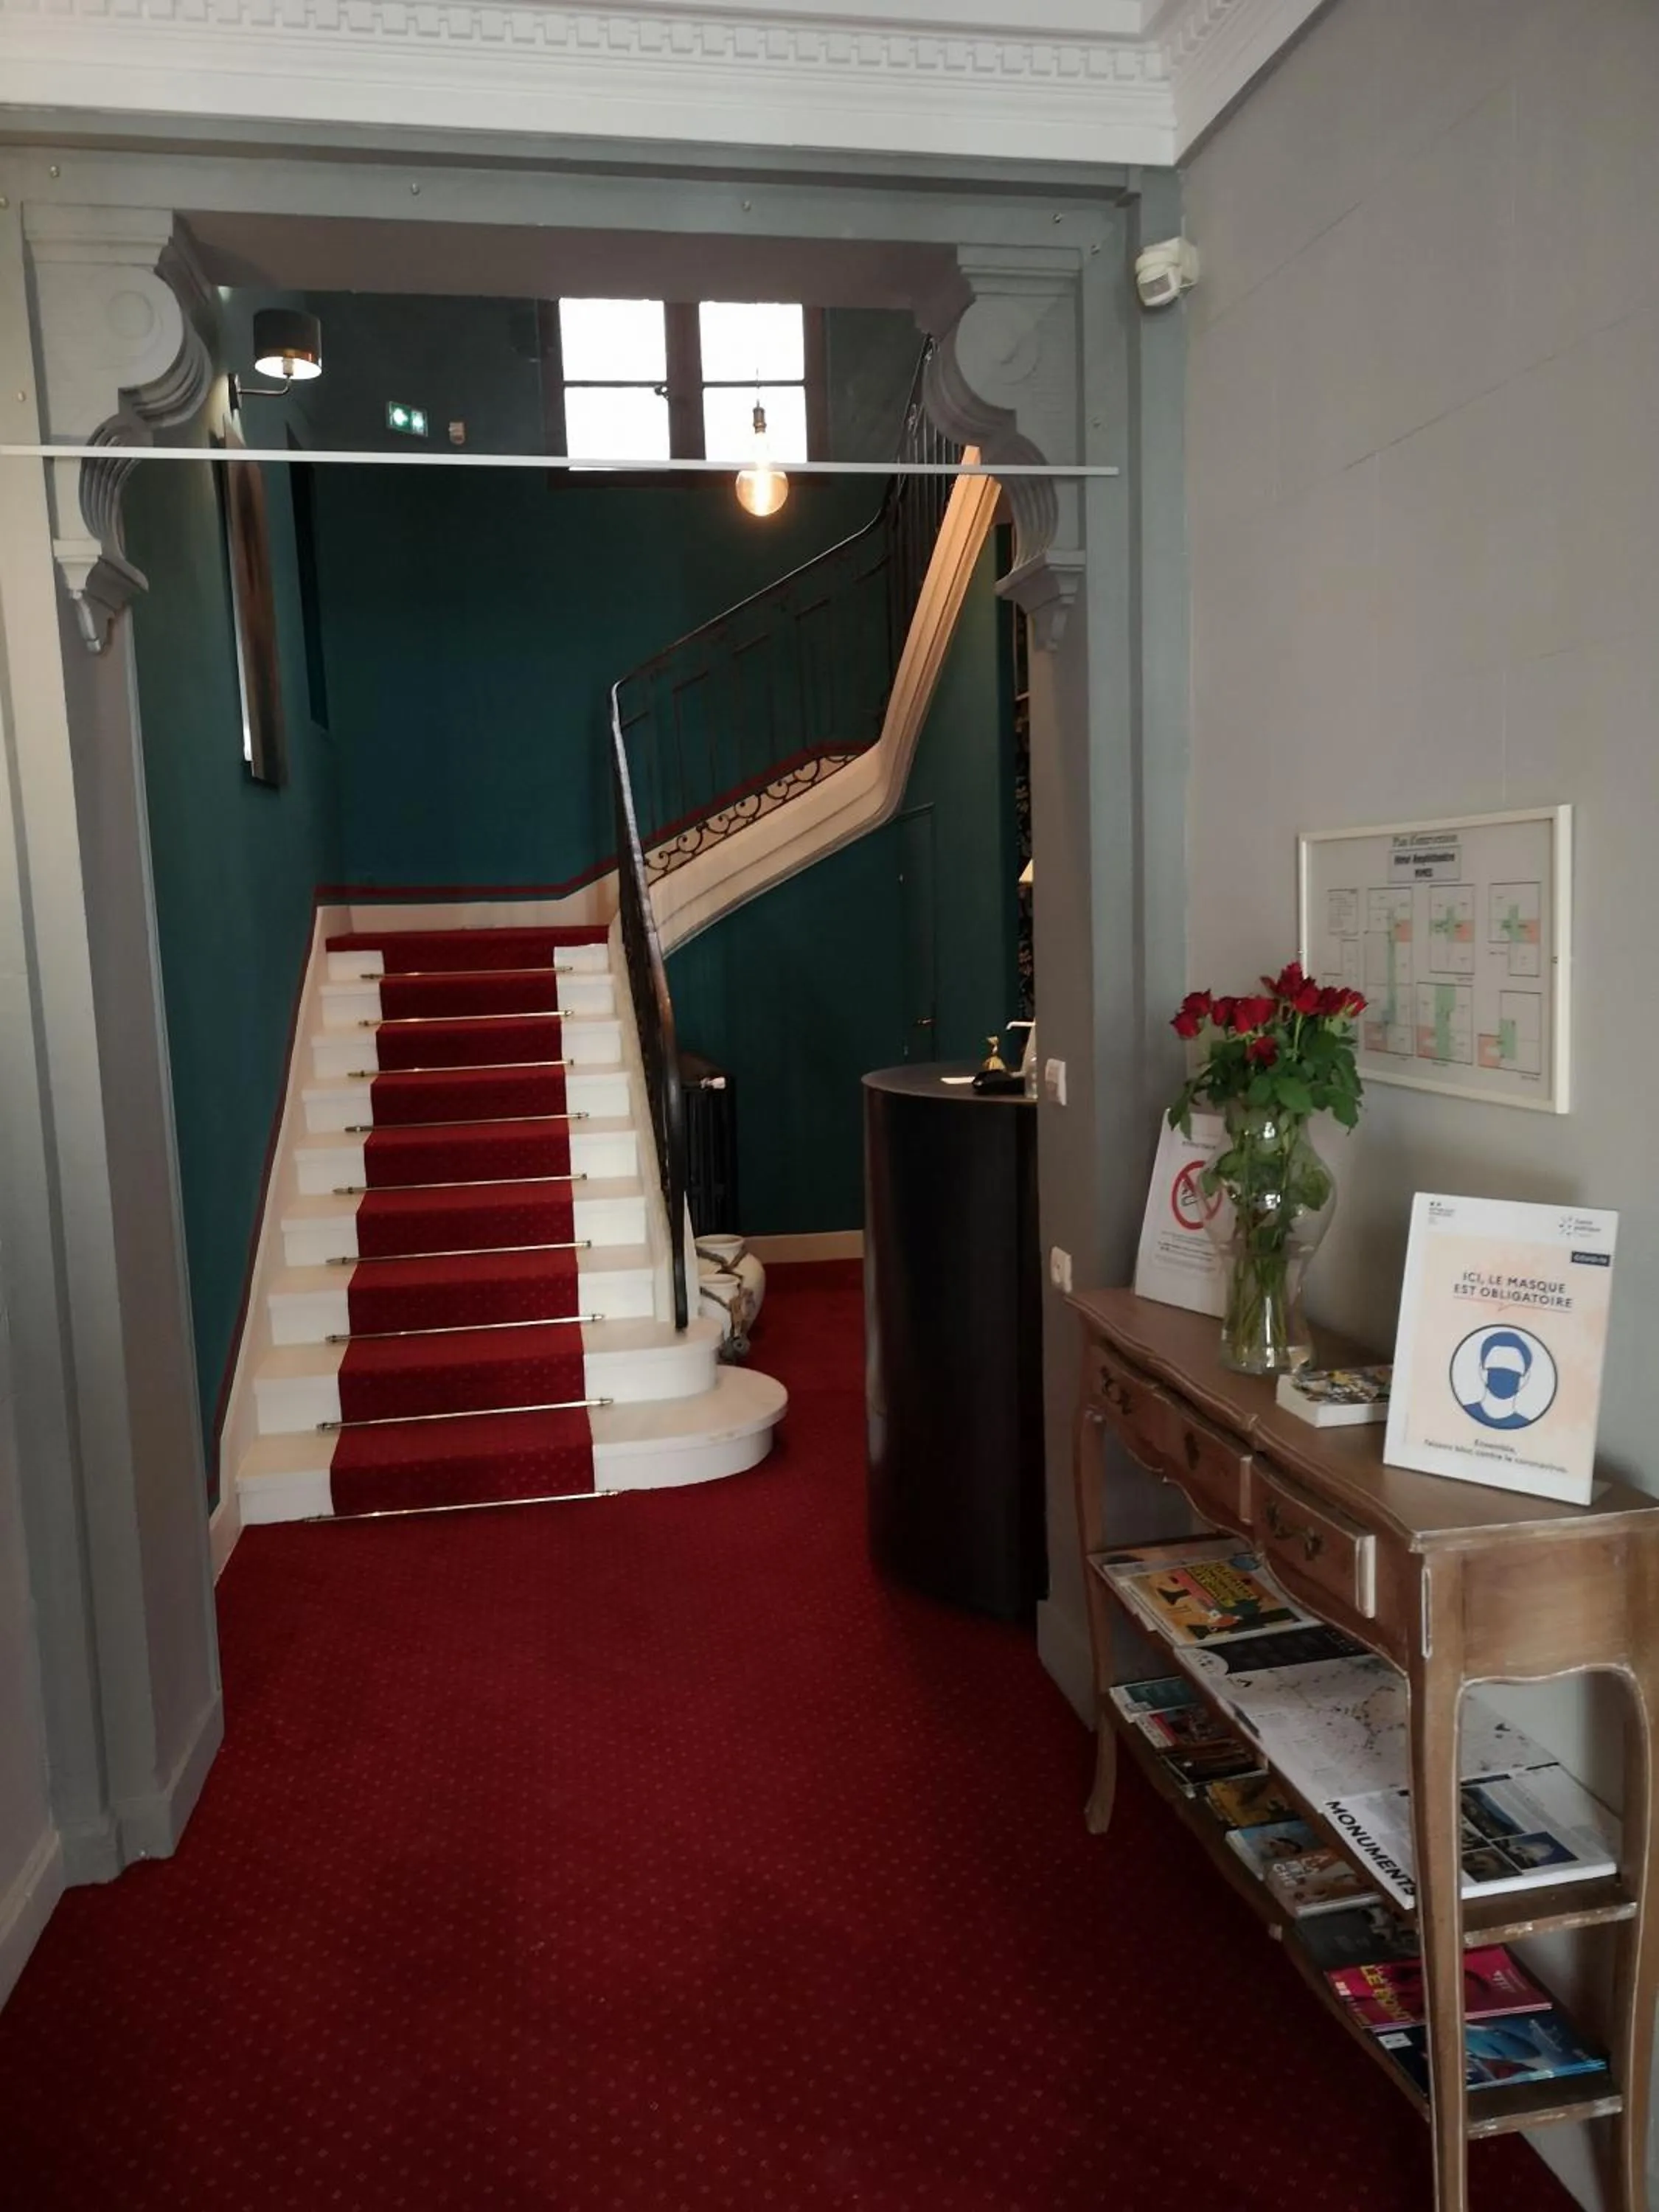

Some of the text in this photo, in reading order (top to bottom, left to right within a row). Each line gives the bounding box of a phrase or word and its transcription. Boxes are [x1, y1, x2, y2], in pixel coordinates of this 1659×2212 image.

[1462, 1271, 1566, 1293] ICI, LE MASQUE
[1454, 1283, 1573, 1308] EST OBLIGATOIRE
